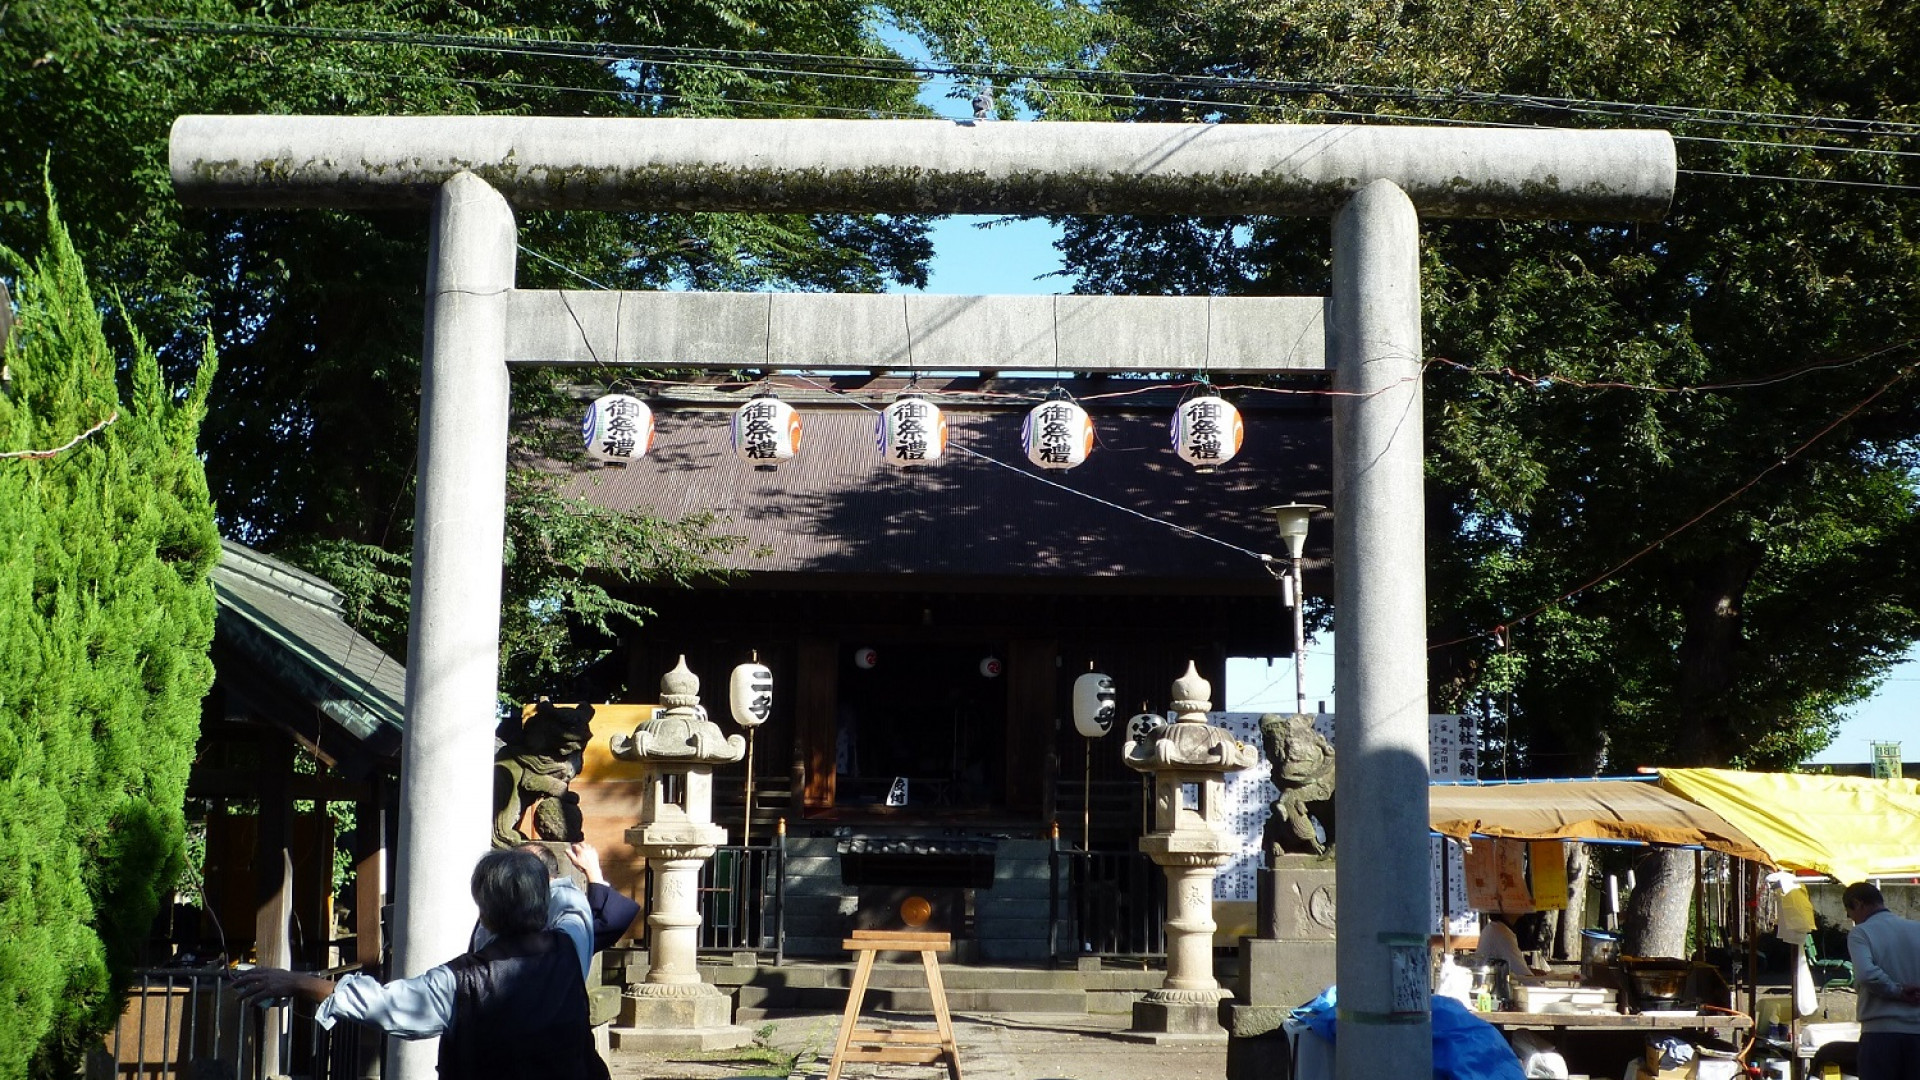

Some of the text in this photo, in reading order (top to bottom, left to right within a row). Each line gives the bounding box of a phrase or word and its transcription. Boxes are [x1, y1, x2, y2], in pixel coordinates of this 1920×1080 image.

[602, 398, 640, 457] 御祭禮
[742, 401, 777, 459] 御祭禮
[894, 402, 928, 461] 御祭禮
[1039, 403, 1074, 463] 御祭禮
[1187, 401, 1222, 460] 御祭禮
[1458, 716, 1476, 781] 神社奉納
[891, 778, 906, 804] 受付
